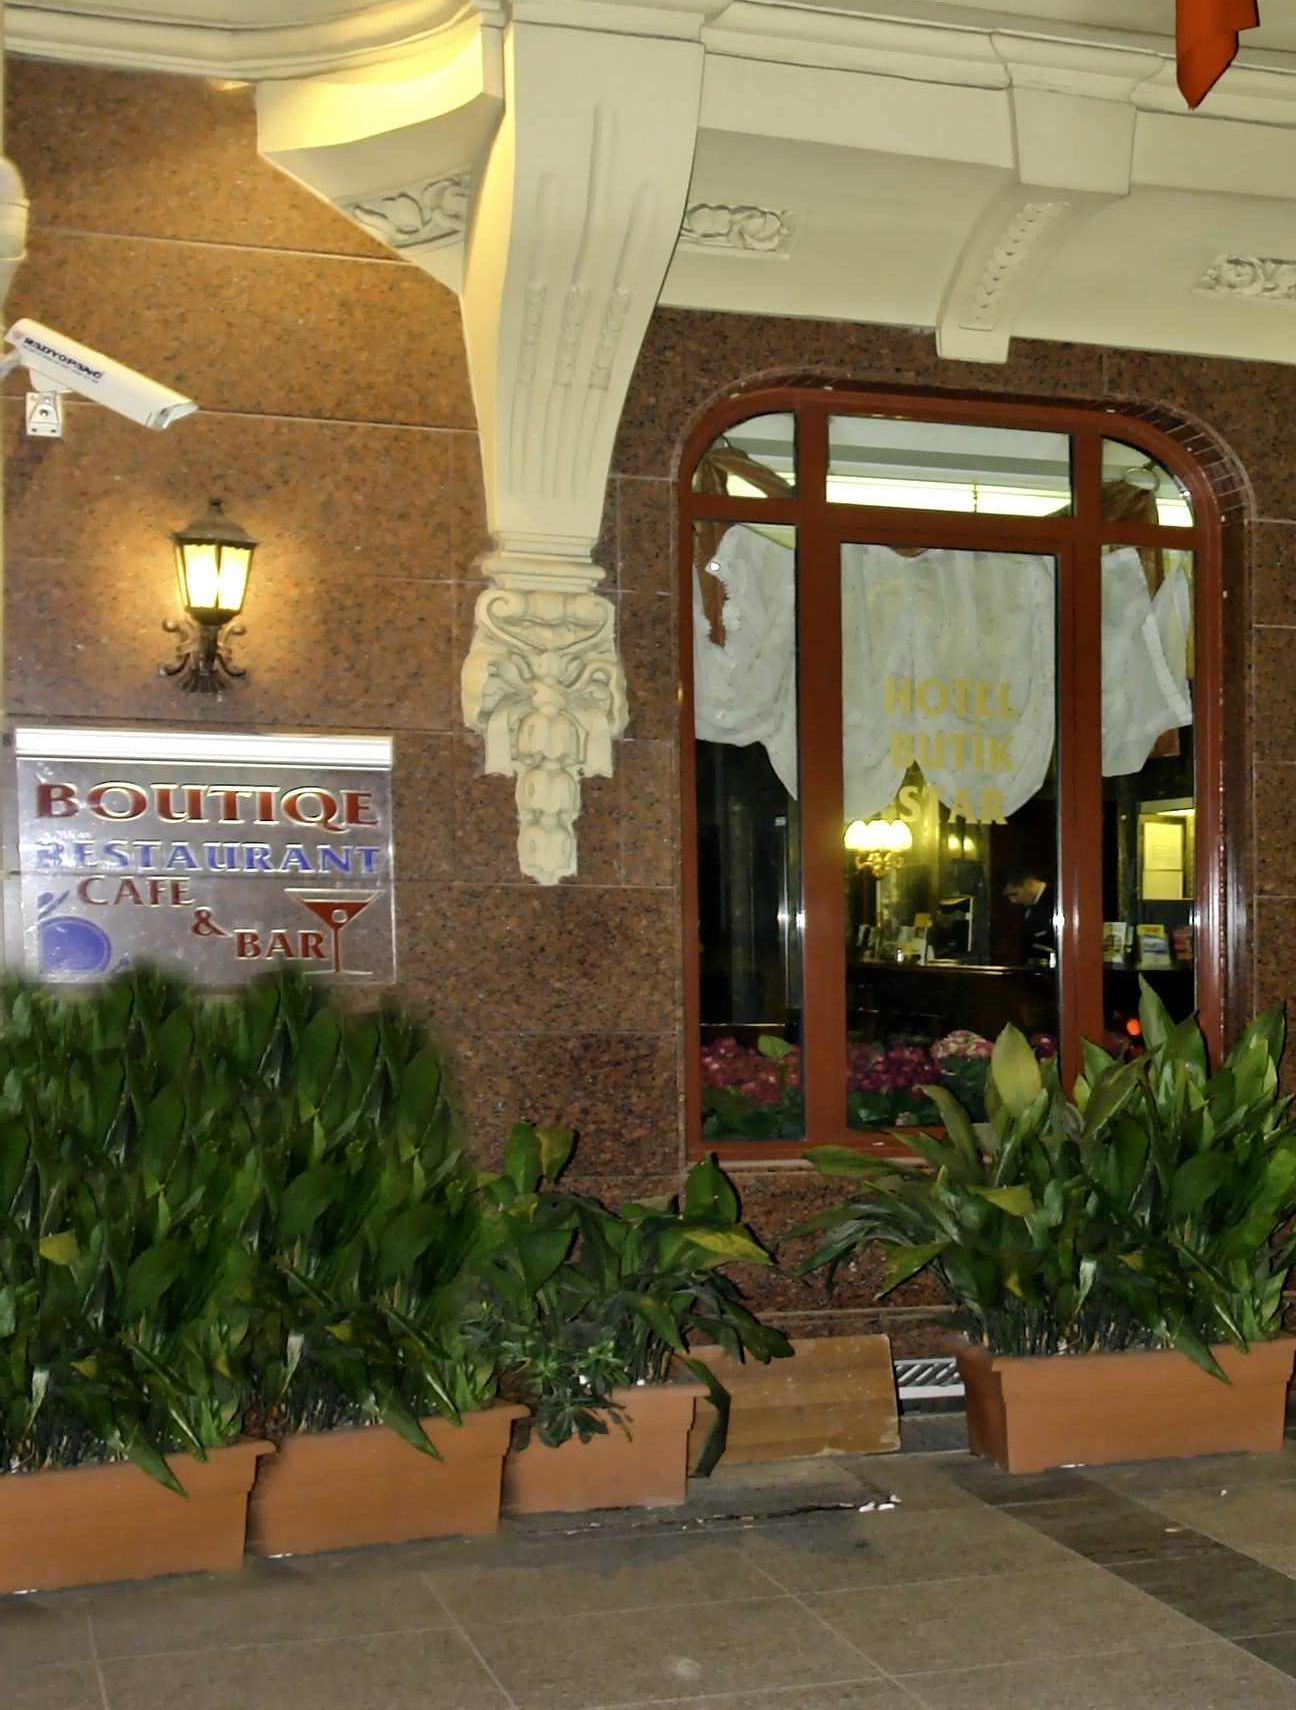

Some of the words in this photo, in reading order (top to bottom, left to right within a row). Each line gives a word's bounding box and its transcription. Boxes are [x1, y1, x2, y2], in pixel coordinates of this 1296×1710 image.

[884, 676, 1018, 719] HOTEL
[889, 722, 1014, 771] BUTİK
[36, 780, 381, 833] BOUTIQE
[899, 785, 1008, 825] STAR
[36, 839, 380, 875] RESTAURANT
[76, 875, 196, 908] CAFE
[189, 906, 234, 938] &
[233, 929, 328, 961] BAR
